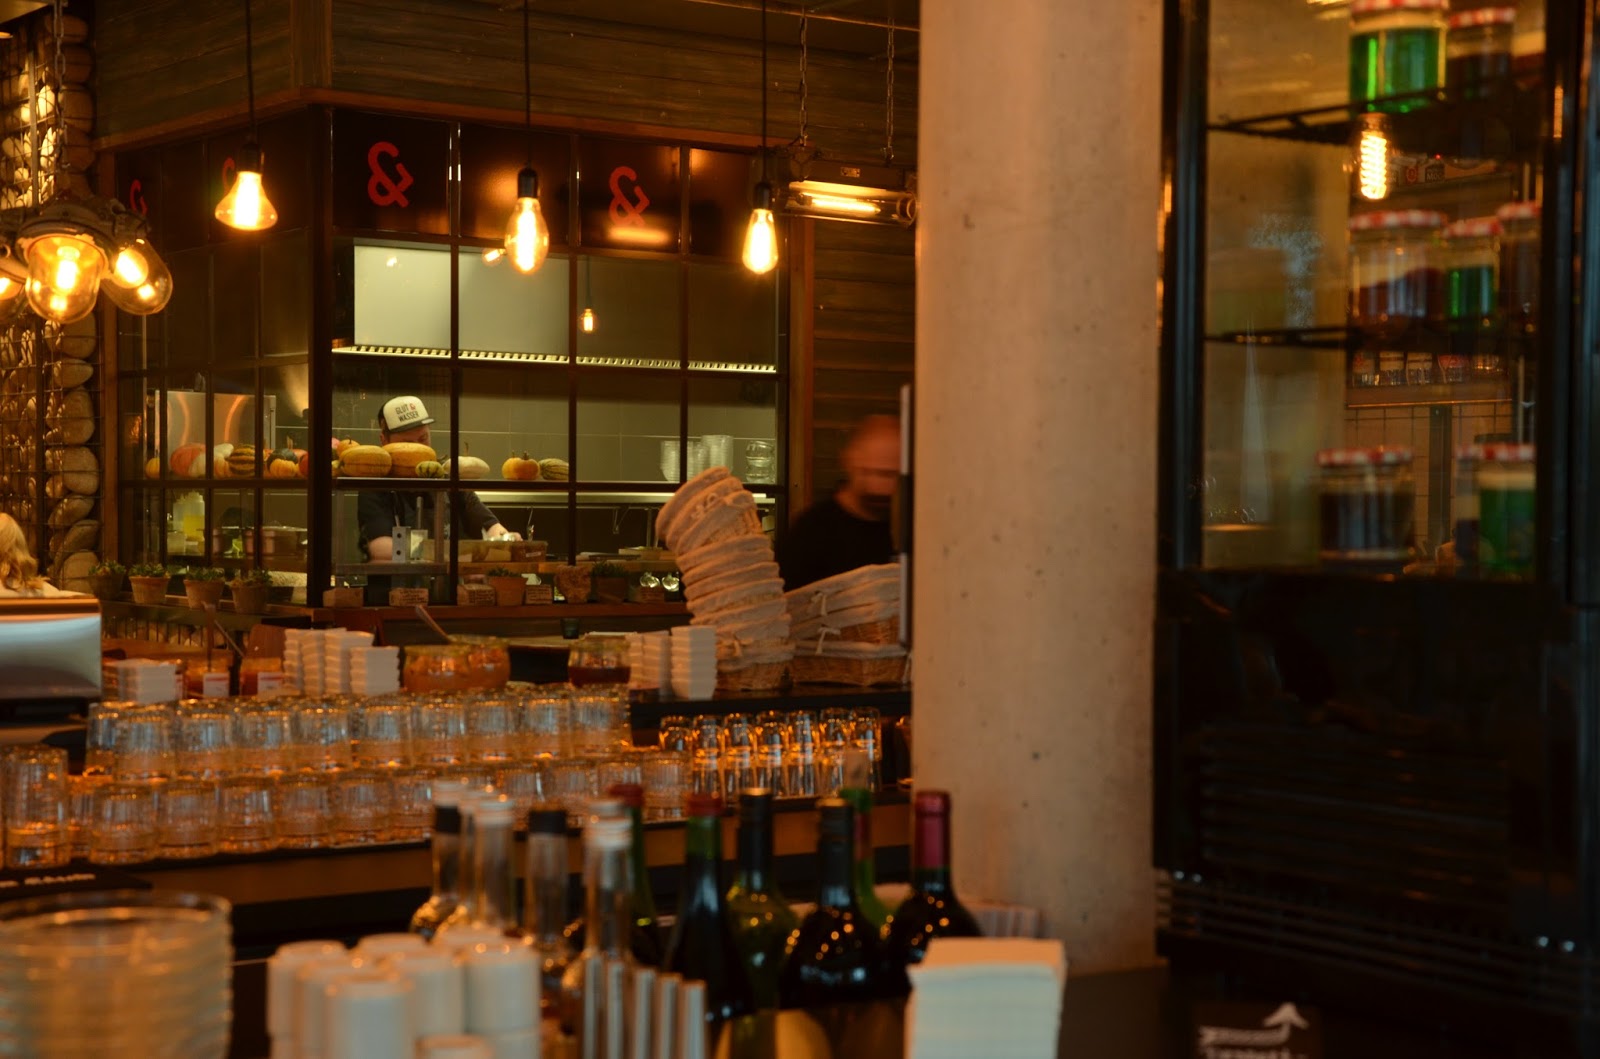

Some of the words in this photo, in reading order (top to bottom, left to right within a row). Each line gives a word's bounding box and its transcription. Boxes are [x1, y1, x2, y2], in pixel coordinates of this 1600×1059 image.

[368, 141, 414, 208] &
[609, 166, 650, 226] &
[395, 404, 408, 415] GLUT
[397, 411, 419, 422] WASSER
